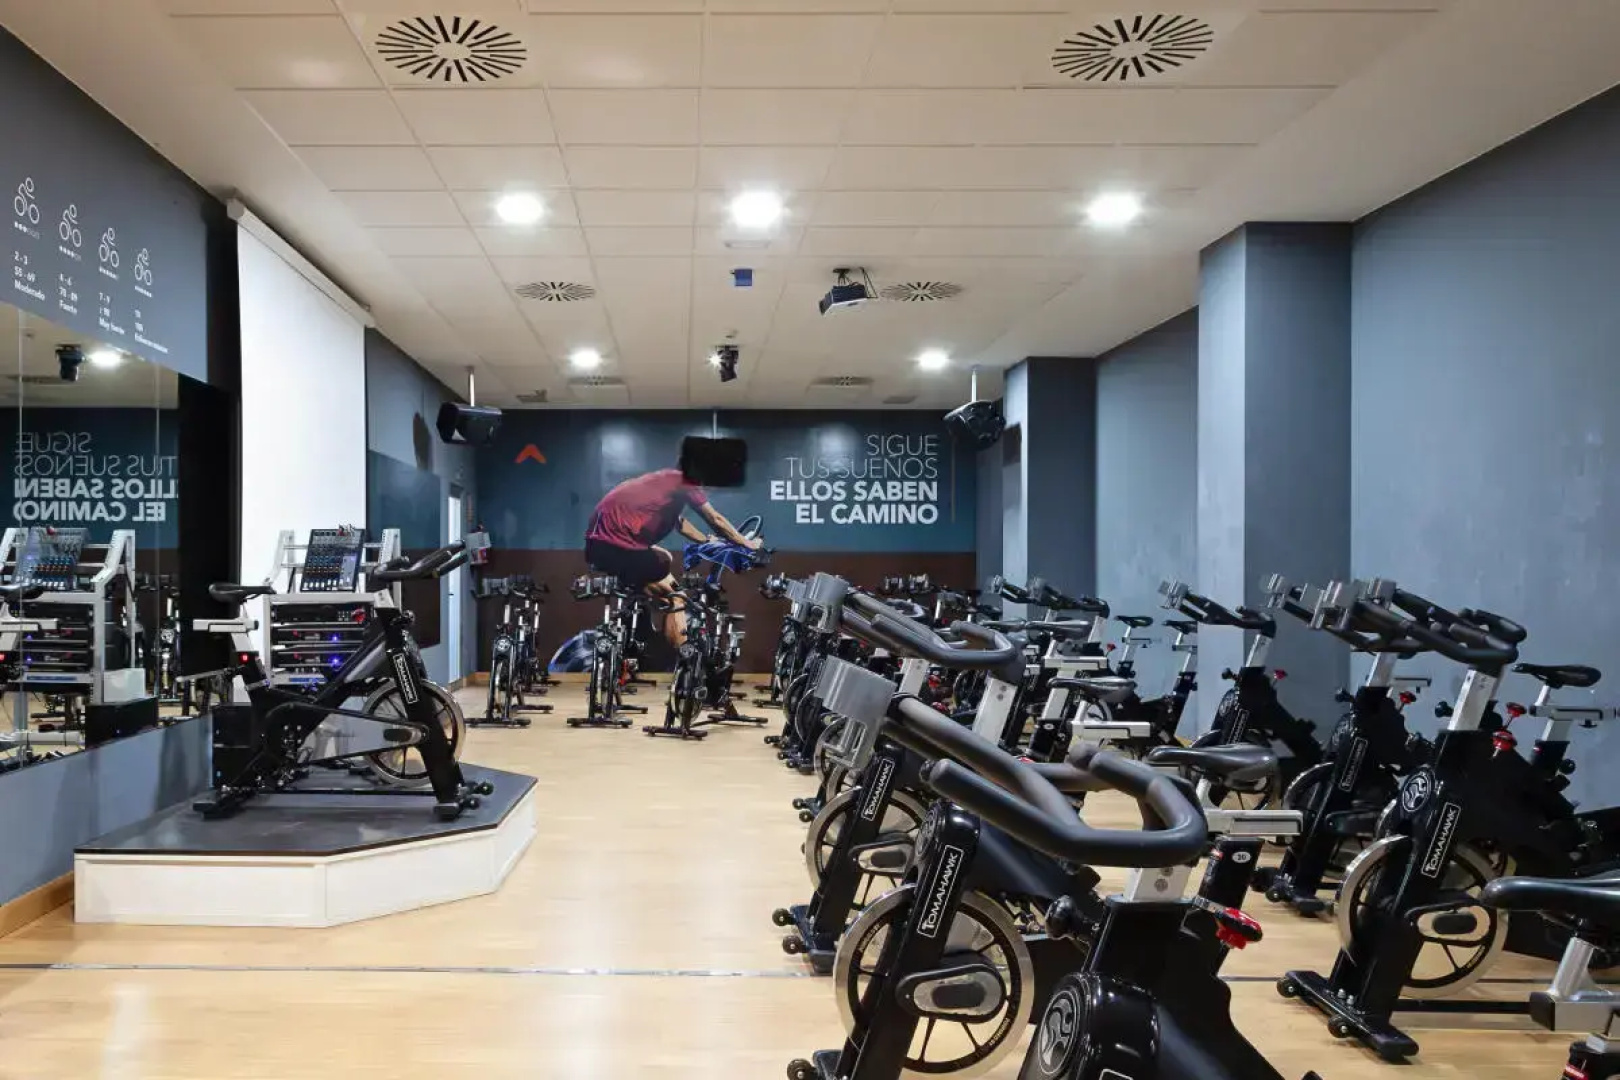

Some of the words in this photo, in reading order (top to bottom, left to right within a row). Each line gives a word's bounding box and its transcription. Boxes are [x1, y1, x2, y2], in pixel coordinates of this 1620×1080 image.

[867, 434, 938, 455] SIGUE
[785, 457, 830, 478] TUS
[770, 480, 847, 501] ELLOS
[853, 480, 938, 501] SABEN
[796, 503, 825, 524] EL
[831, 503, 939, 525] CAMINO
[864, 763, 892, 815] TOMAHAWK
[1424, 807, 1457, 872] TOMAHAWK
[921, 851, 958, 931] TOMAHAWK
